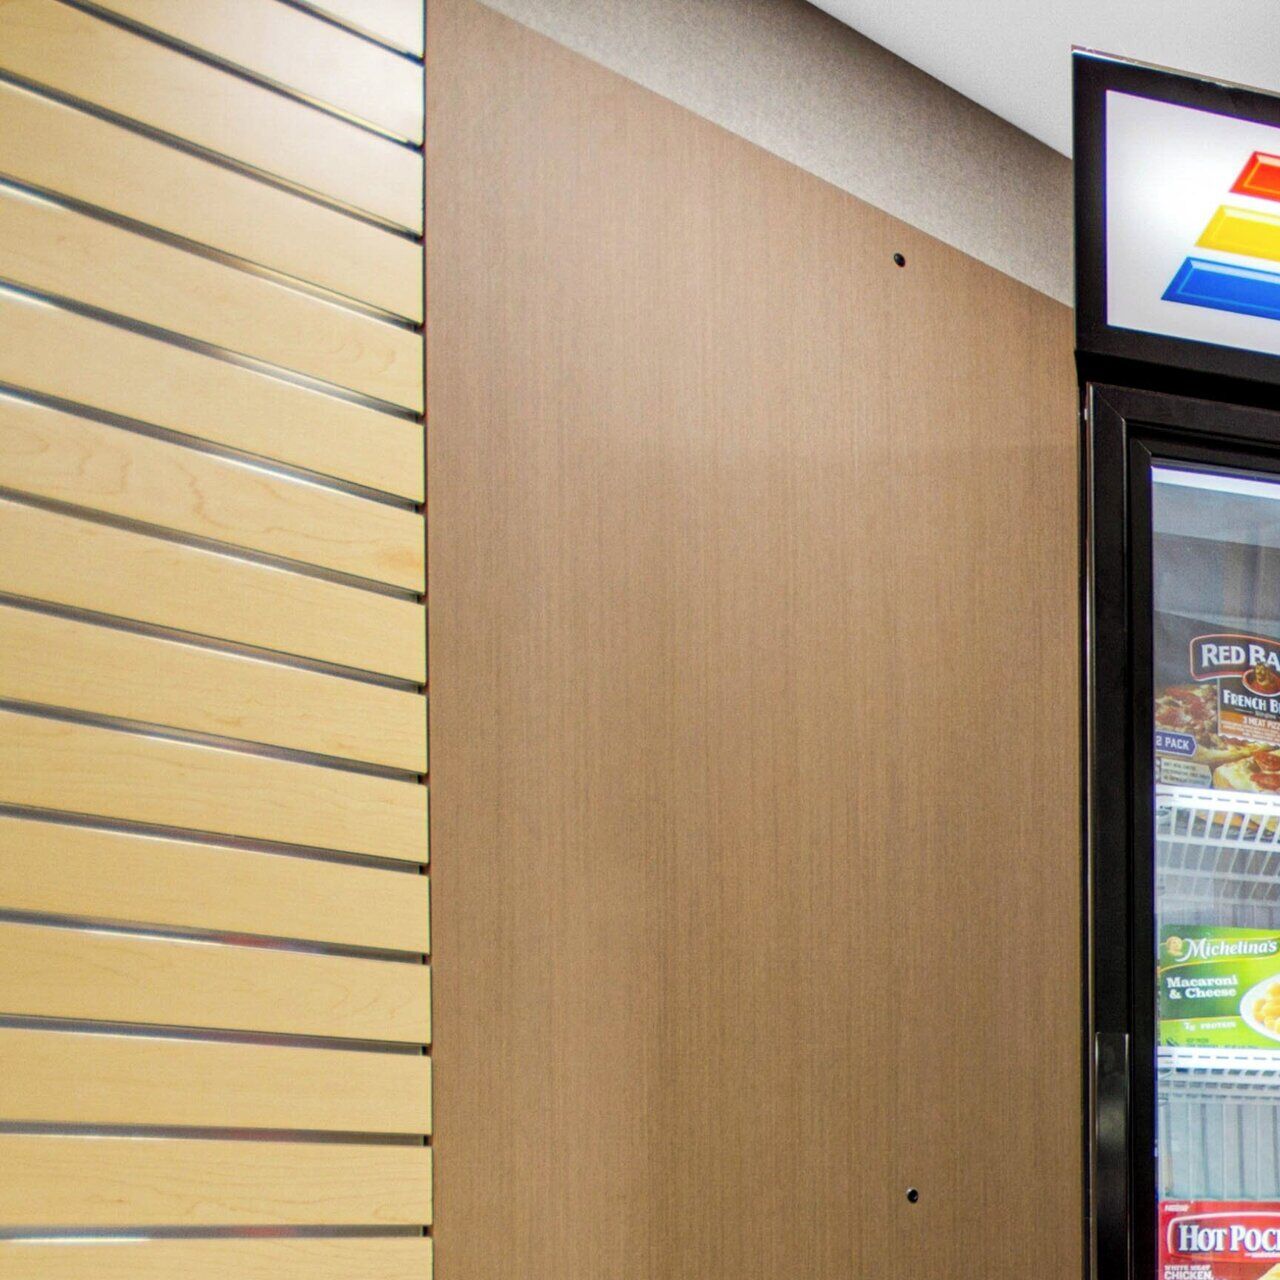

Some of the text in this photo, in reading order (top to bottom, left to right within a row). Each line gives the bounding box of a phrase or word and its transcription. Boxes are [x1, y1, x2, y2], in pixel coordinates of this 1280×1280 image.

[1202, 643, 1246, 668] RED
[1222, 689, 1267, 711] FRENCH
[1156, 735, 1190, 751] 2 PACK
[1175, 932, 1279, 962] Michelina's
[1166, 974, 1239, 988] Macaroni
[1169, 986, 1237, 1000] & Cheese
[1178, 1224, 1227, 1252] HOT
[1164, 1271, 1214, 1280] CHICKEN,
